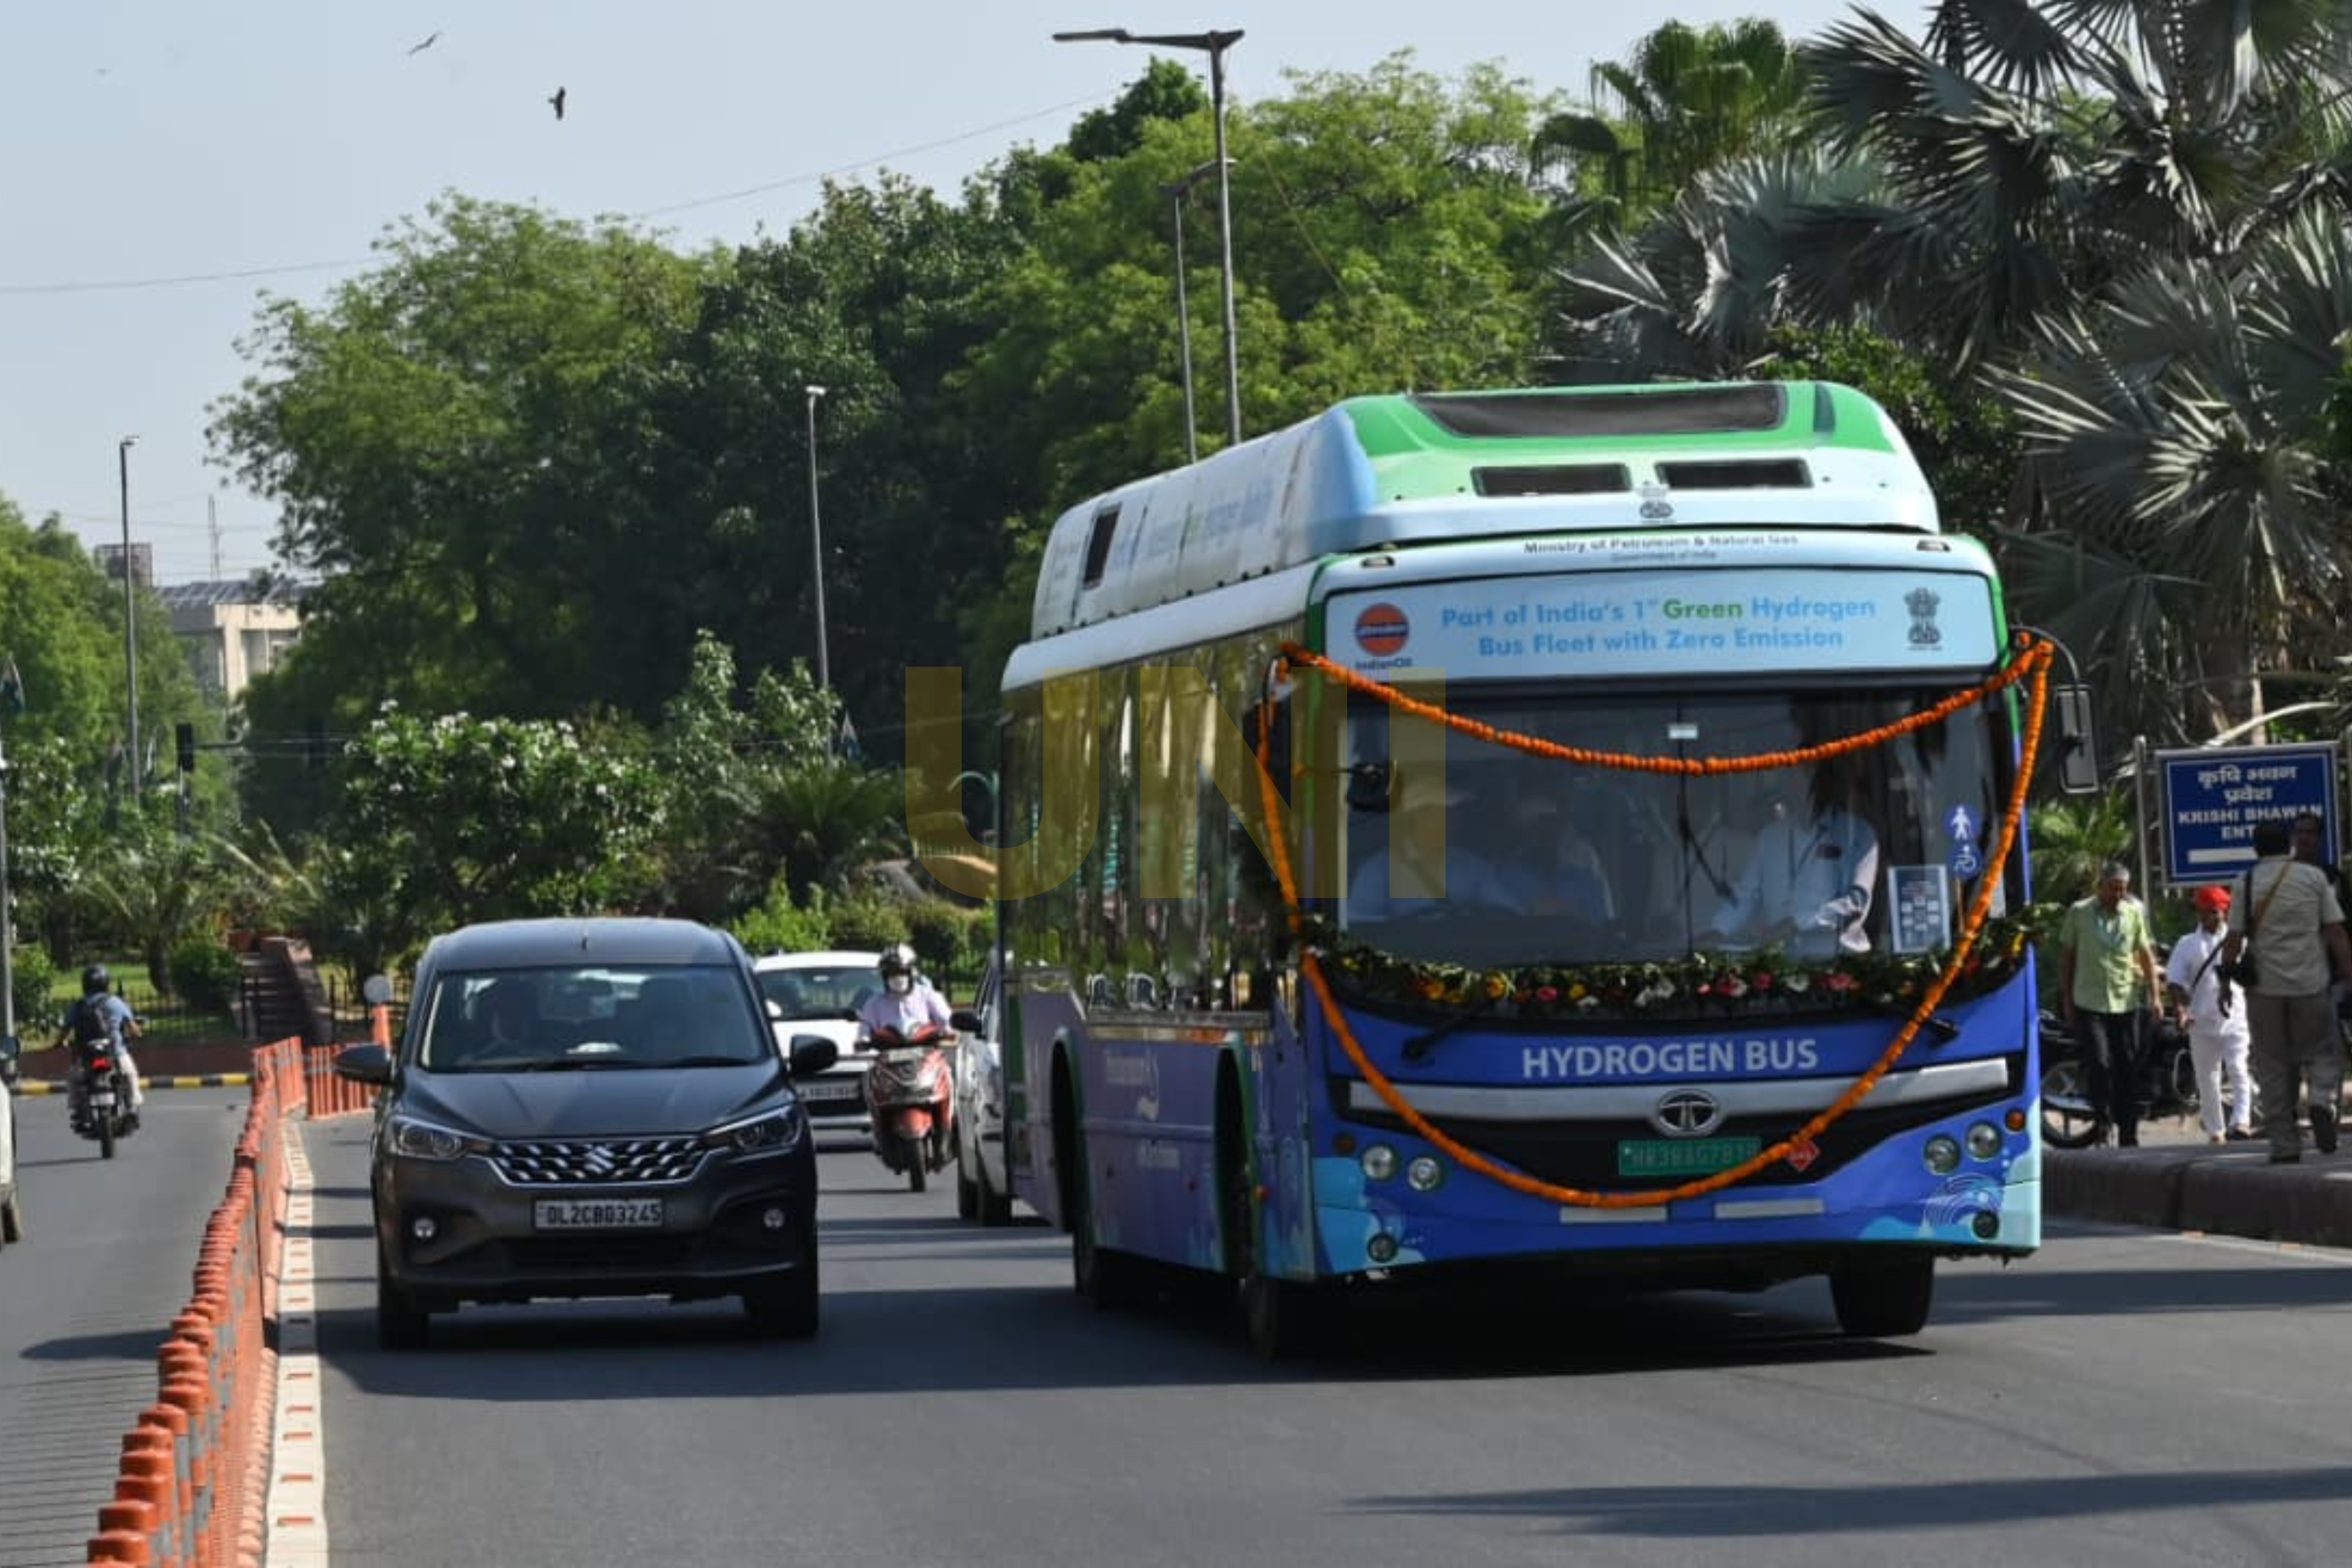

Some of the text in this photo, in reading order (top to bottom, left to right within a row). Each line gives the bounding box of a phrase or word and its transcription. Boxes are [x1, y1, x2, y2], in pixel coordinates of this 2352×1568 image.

[1441, 606, 1492, 626] Part
[1504, 603, 1529, 624] of
[1537, 599, 1624, 623] India's
[1663, 599, 1743, 620] Green
[1751, 597, 1875, 622] Hydrogen
[1478, 626, 1843, 656] Bus Fleet with Zero Emission
[2178, 808, 2239, 824] KRISHI
[2221, 824, 2257, 841] ENT
[1522, 1039, 1819, 1079] HYDROGEN BUS
